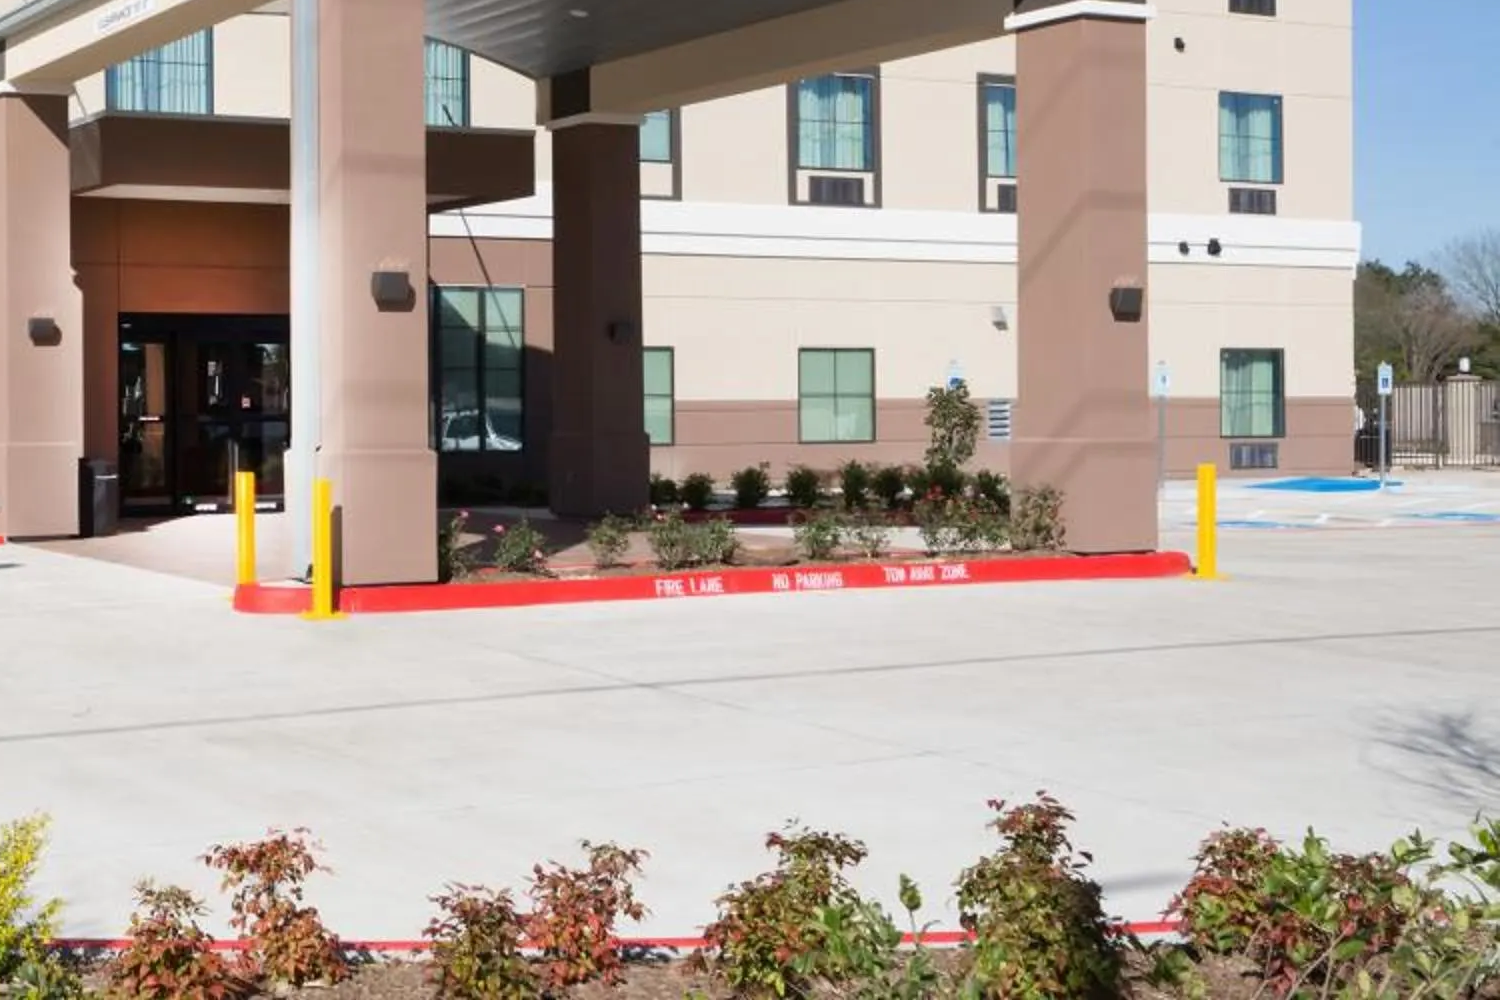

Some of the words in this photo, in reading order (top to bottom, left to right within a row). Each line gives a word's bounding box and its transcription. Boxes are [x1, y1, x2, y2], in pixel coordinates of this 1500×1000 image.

[653, 579, 685, 596] FIRE
[771, 573, 789, 590] NO
[795, 570, 844, 591] PARKING
